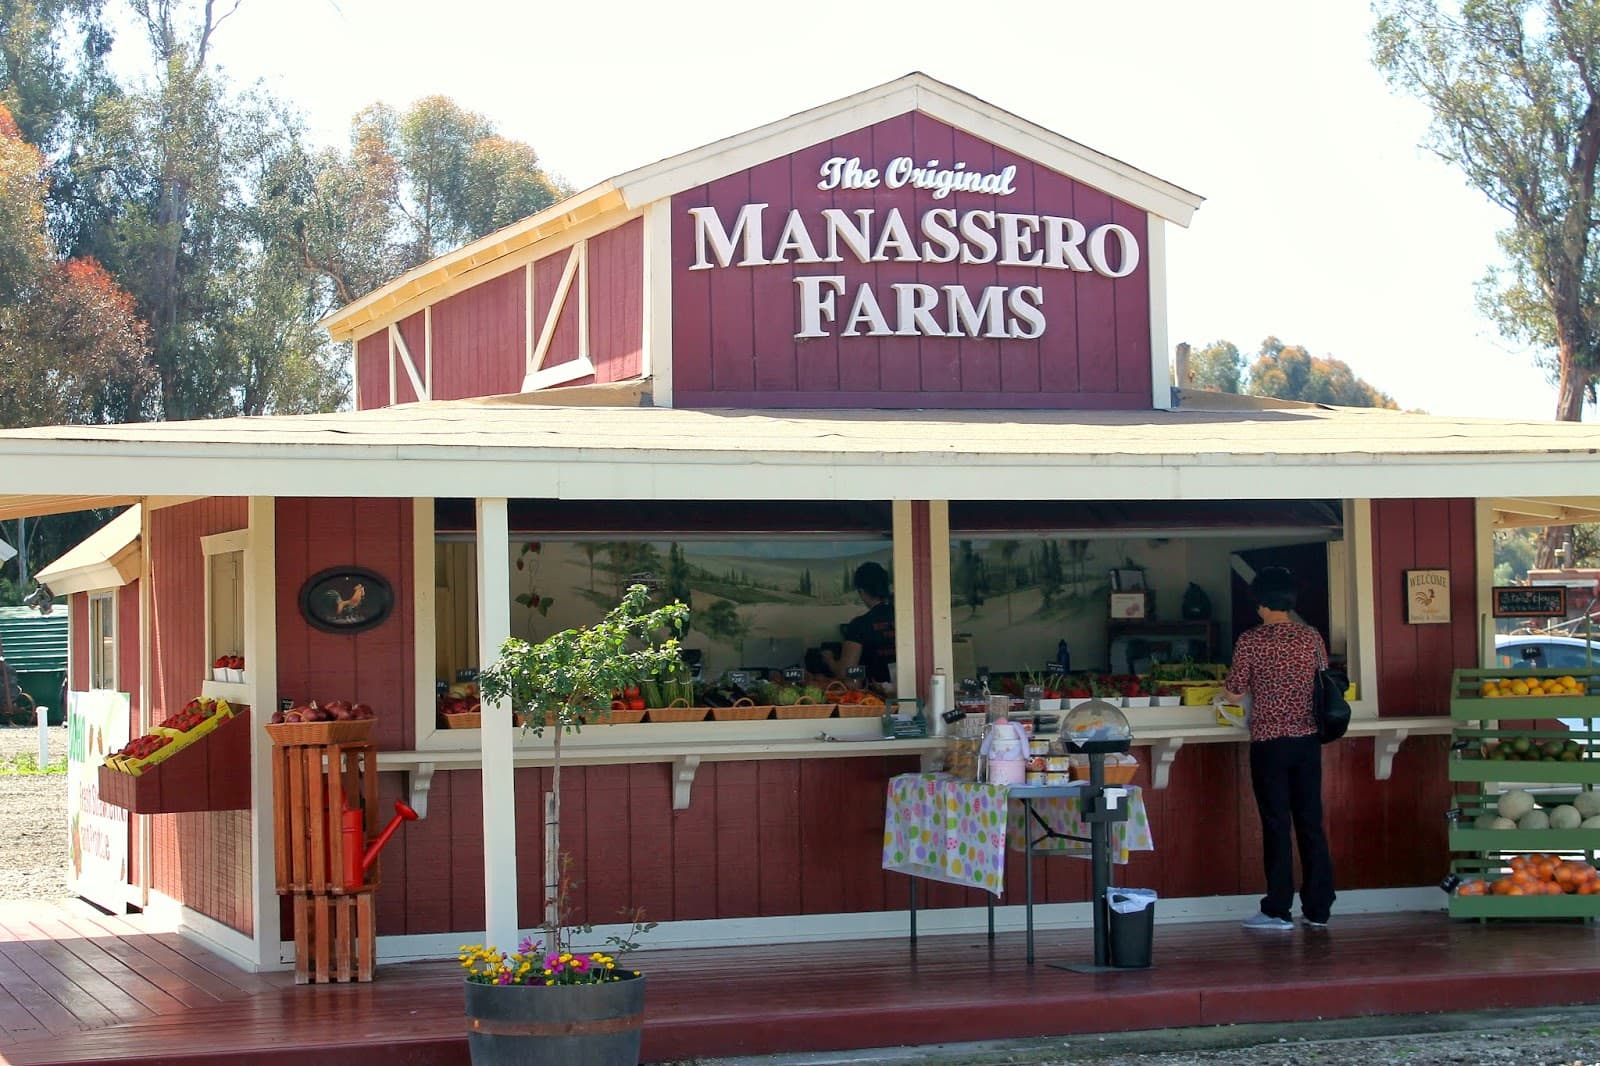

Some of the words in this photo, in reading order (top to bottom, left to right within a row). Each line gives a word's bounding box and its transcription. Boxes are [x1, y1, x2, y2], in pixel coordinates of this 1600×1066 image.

[817, 157, 880, 190] The
[885, 157, 1017, 200] Original
[688, 203, 1139, 278] MANASSERO
[794, 275, 1046, 340] FARMS
[1409, 574, 1447, 588] WELCOME
